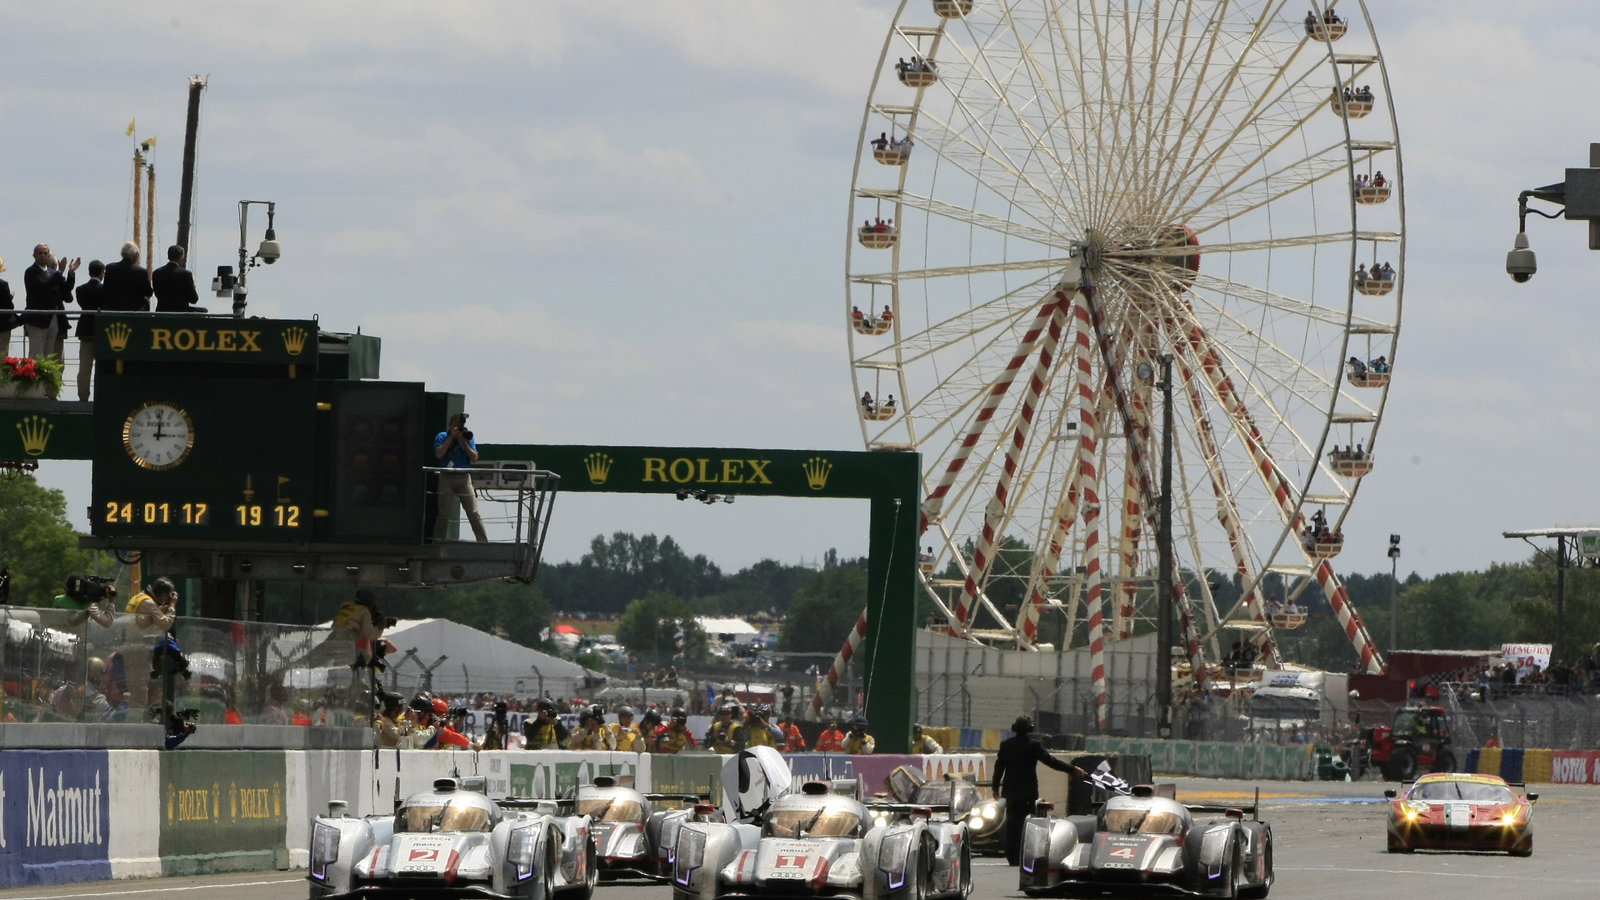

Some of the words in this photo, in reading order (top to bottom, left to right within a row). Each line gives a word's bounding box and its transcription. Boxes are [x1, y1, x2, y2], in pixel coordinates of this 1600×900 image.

[151, 328, 262, 352] ROLEX
[642, 457, 773, 485] ROLEX
[236, 506, 262, 526] 19
[274, 506, 299, 527] 12
[1552, 757, 1588, 784] MOTUL
[27, 767, 102, 847] Matmut
[178, 789, 208, 821] ROLEX
[241, 788, 270, 818] ROLEX
[411, 849, 435, 861] 2
[779, 856, 801, 868] 1
[1110, 848, 1134, 859] 4
